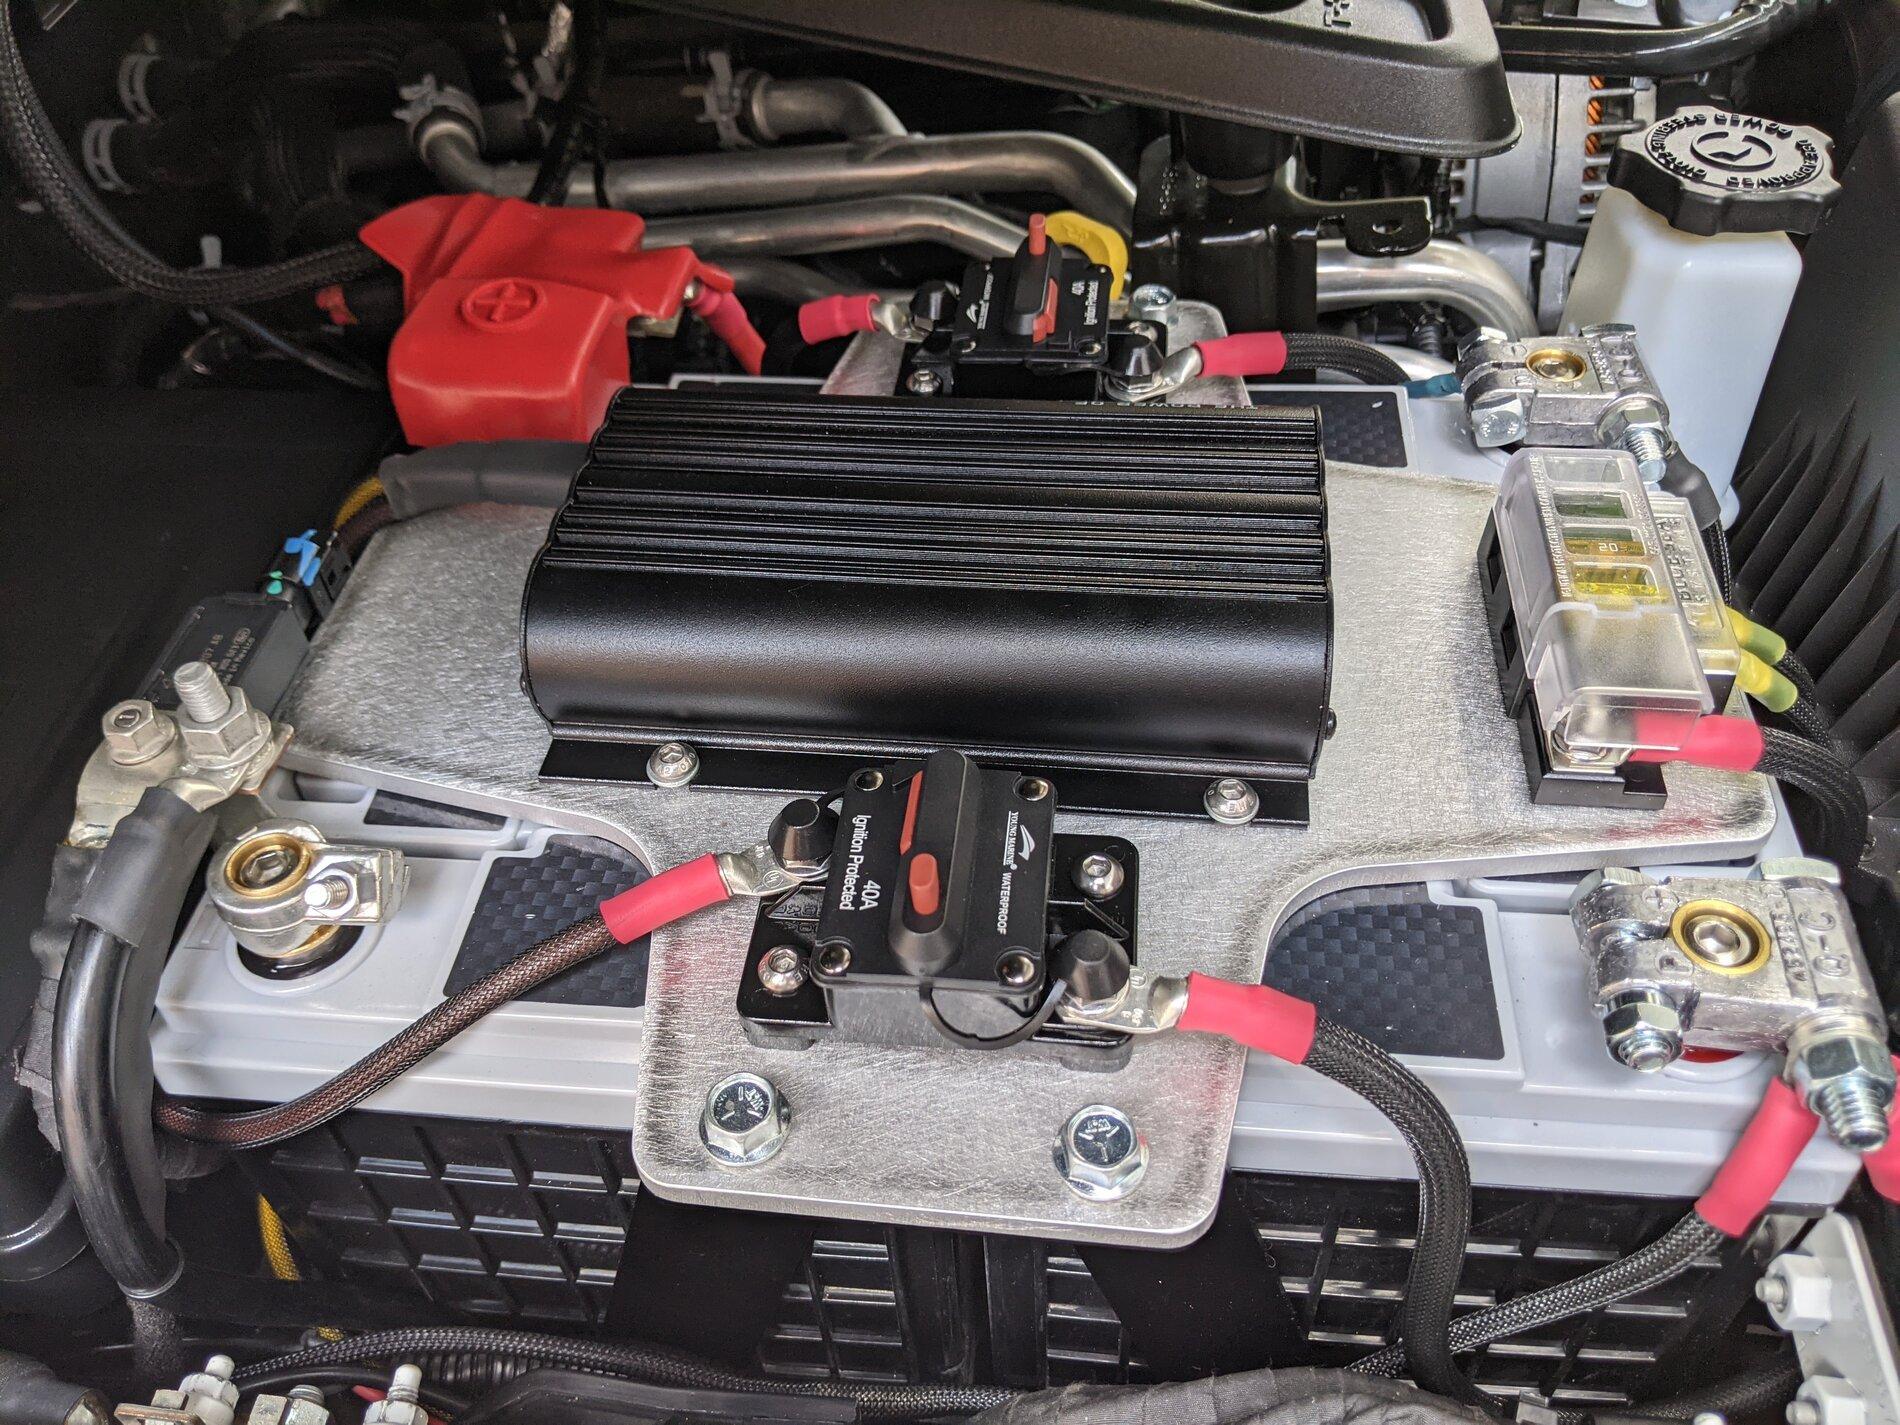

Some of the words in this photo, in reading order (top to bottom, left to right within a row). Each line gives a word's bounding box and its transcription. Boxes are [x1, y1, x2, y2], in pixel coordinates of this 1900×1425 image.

[1598, 542, 1619, 552] 20
[851, 814, 872, 853] Ignition
[839, 854, 865, 911] Protected
[859, 879, 882, 911] 40A
[997, 872, 1012, 935] WATERPROOF
